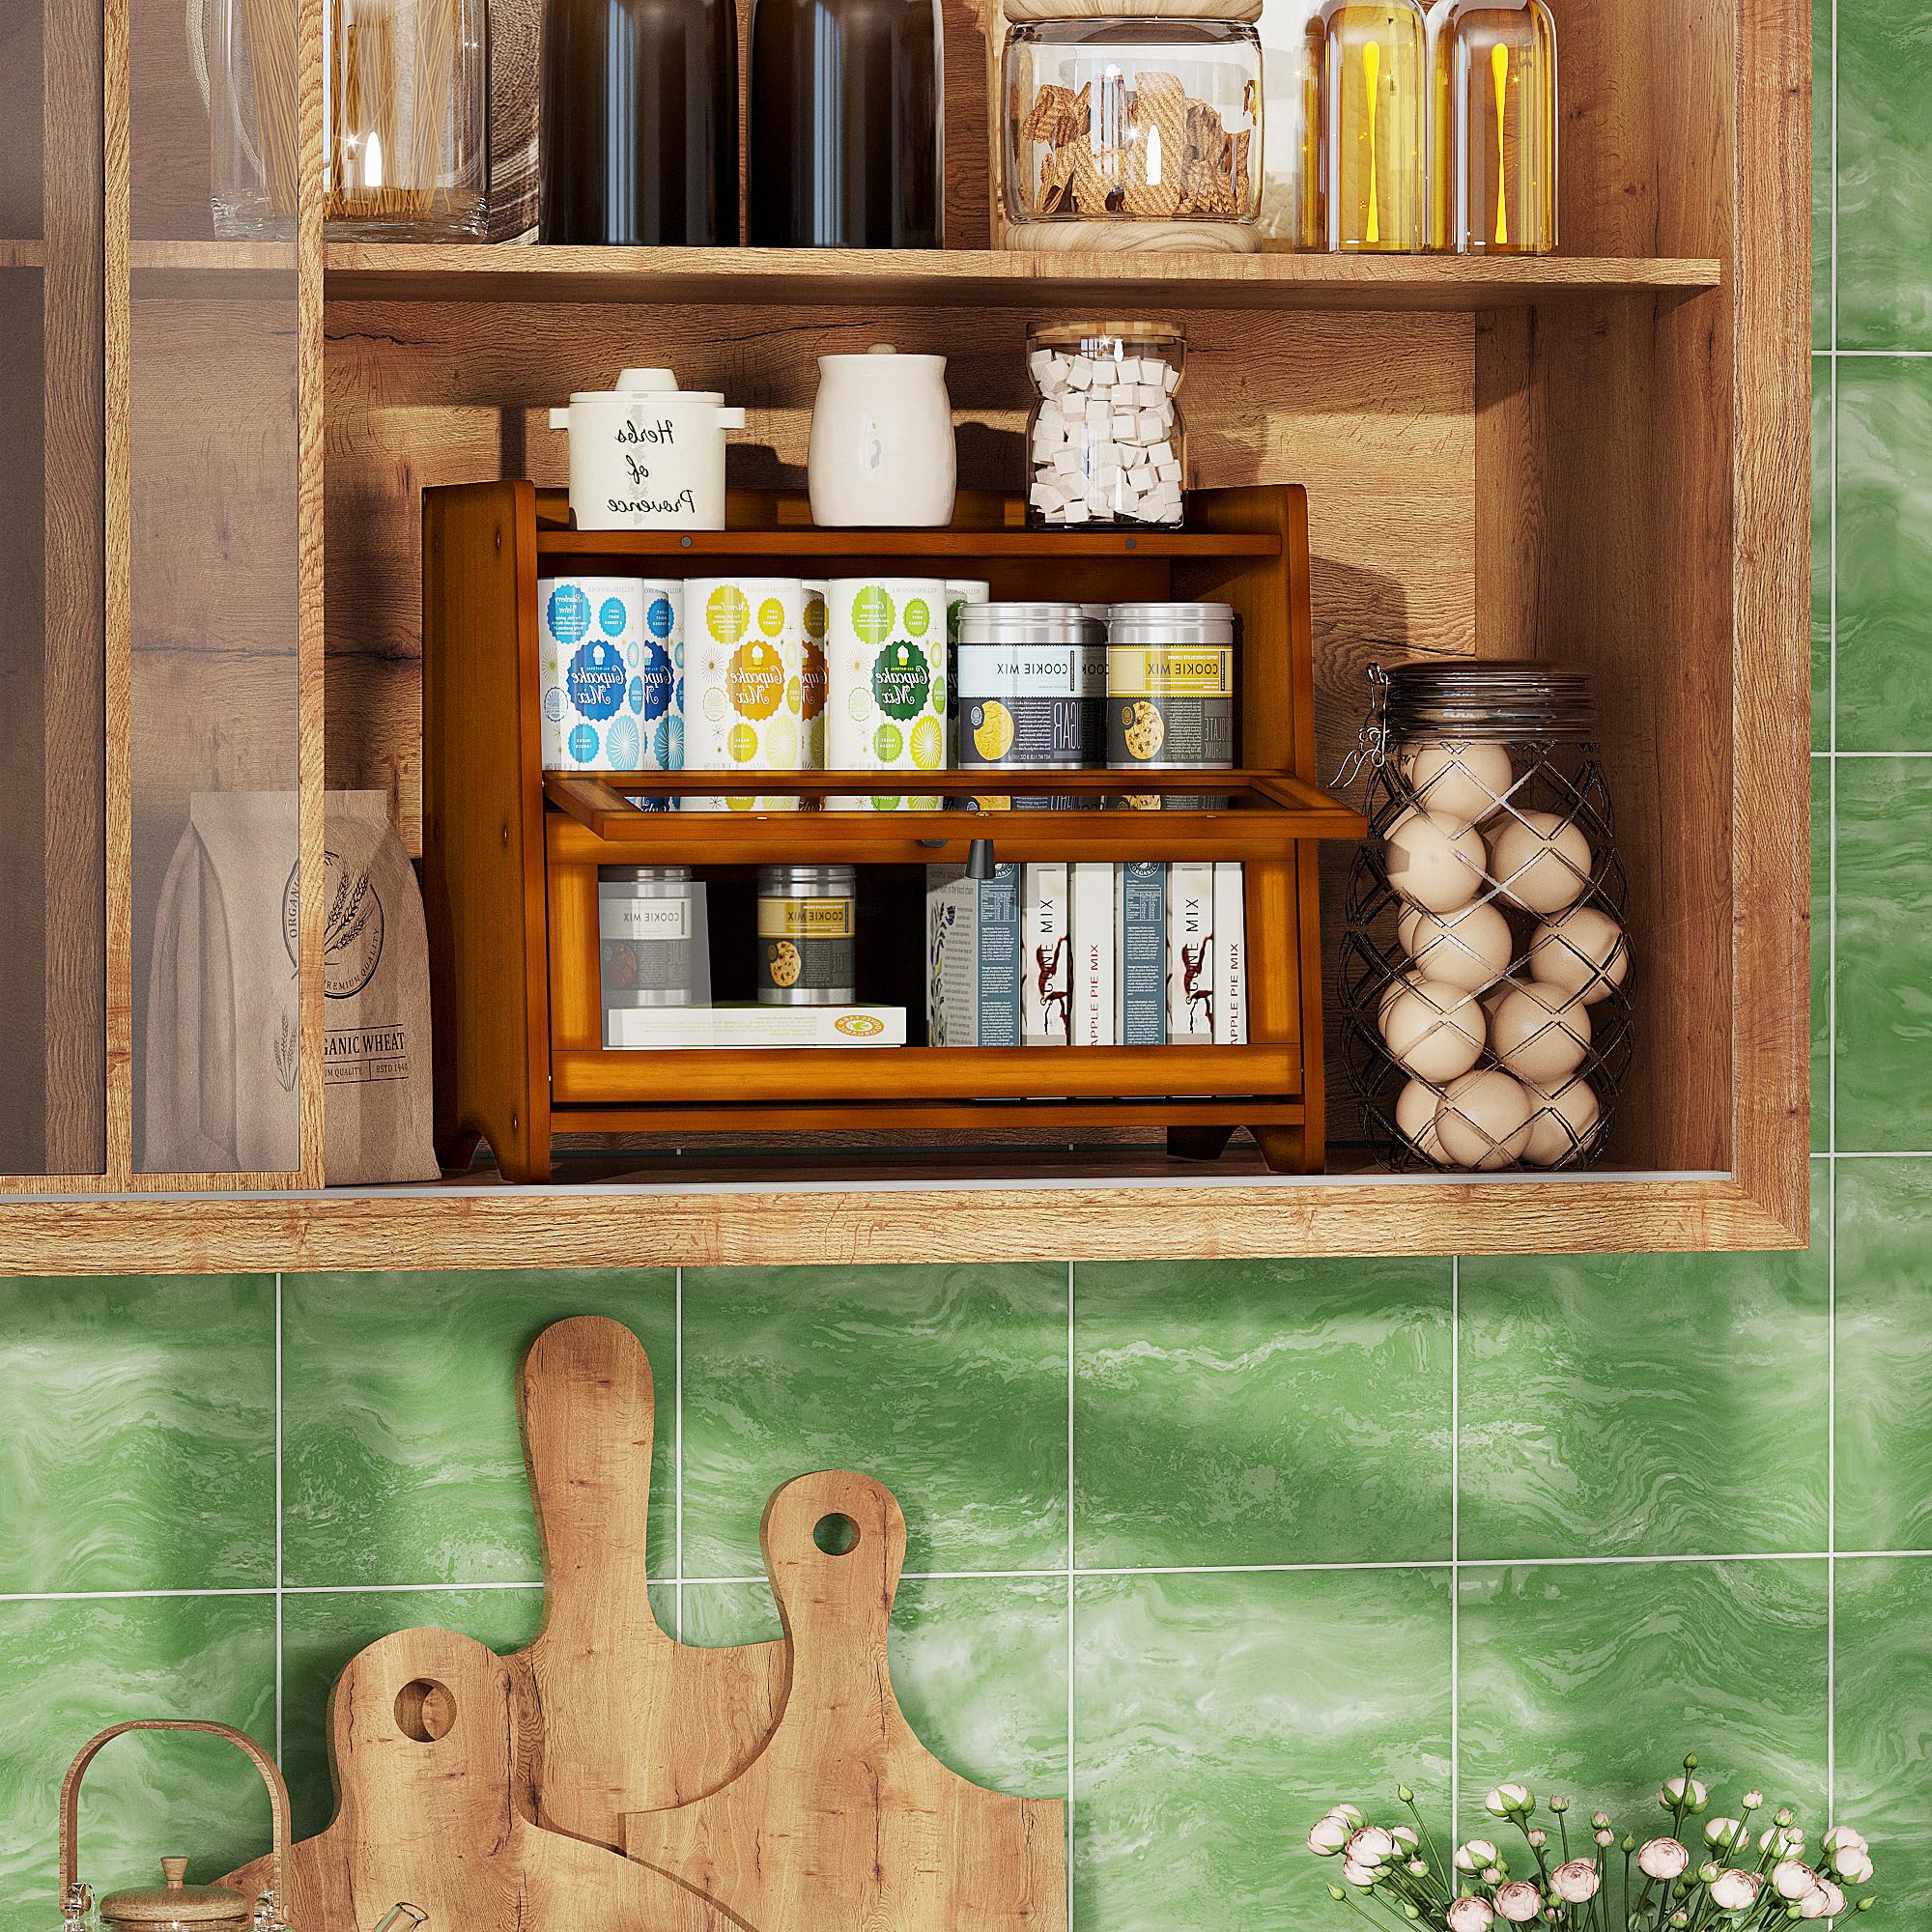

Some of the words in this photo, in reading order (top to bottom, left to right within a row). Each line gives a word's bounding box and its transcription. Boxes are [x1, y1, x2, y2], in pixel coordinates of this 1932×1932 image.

[1131, 865, 1157, 876] ORGANIC
[1040, 899, 1054, 933] MIX
[1185, 898, 1199, 932] MIX
[360, 928, 381, 979] QUALITY
[325, 1036, 360, 1056] ANIC
[362, 1032, 405, 1053] WHEAT
[334, 1066, 363, 1078] QUALITY
[376, 1064, 393, 1073] ESTD
